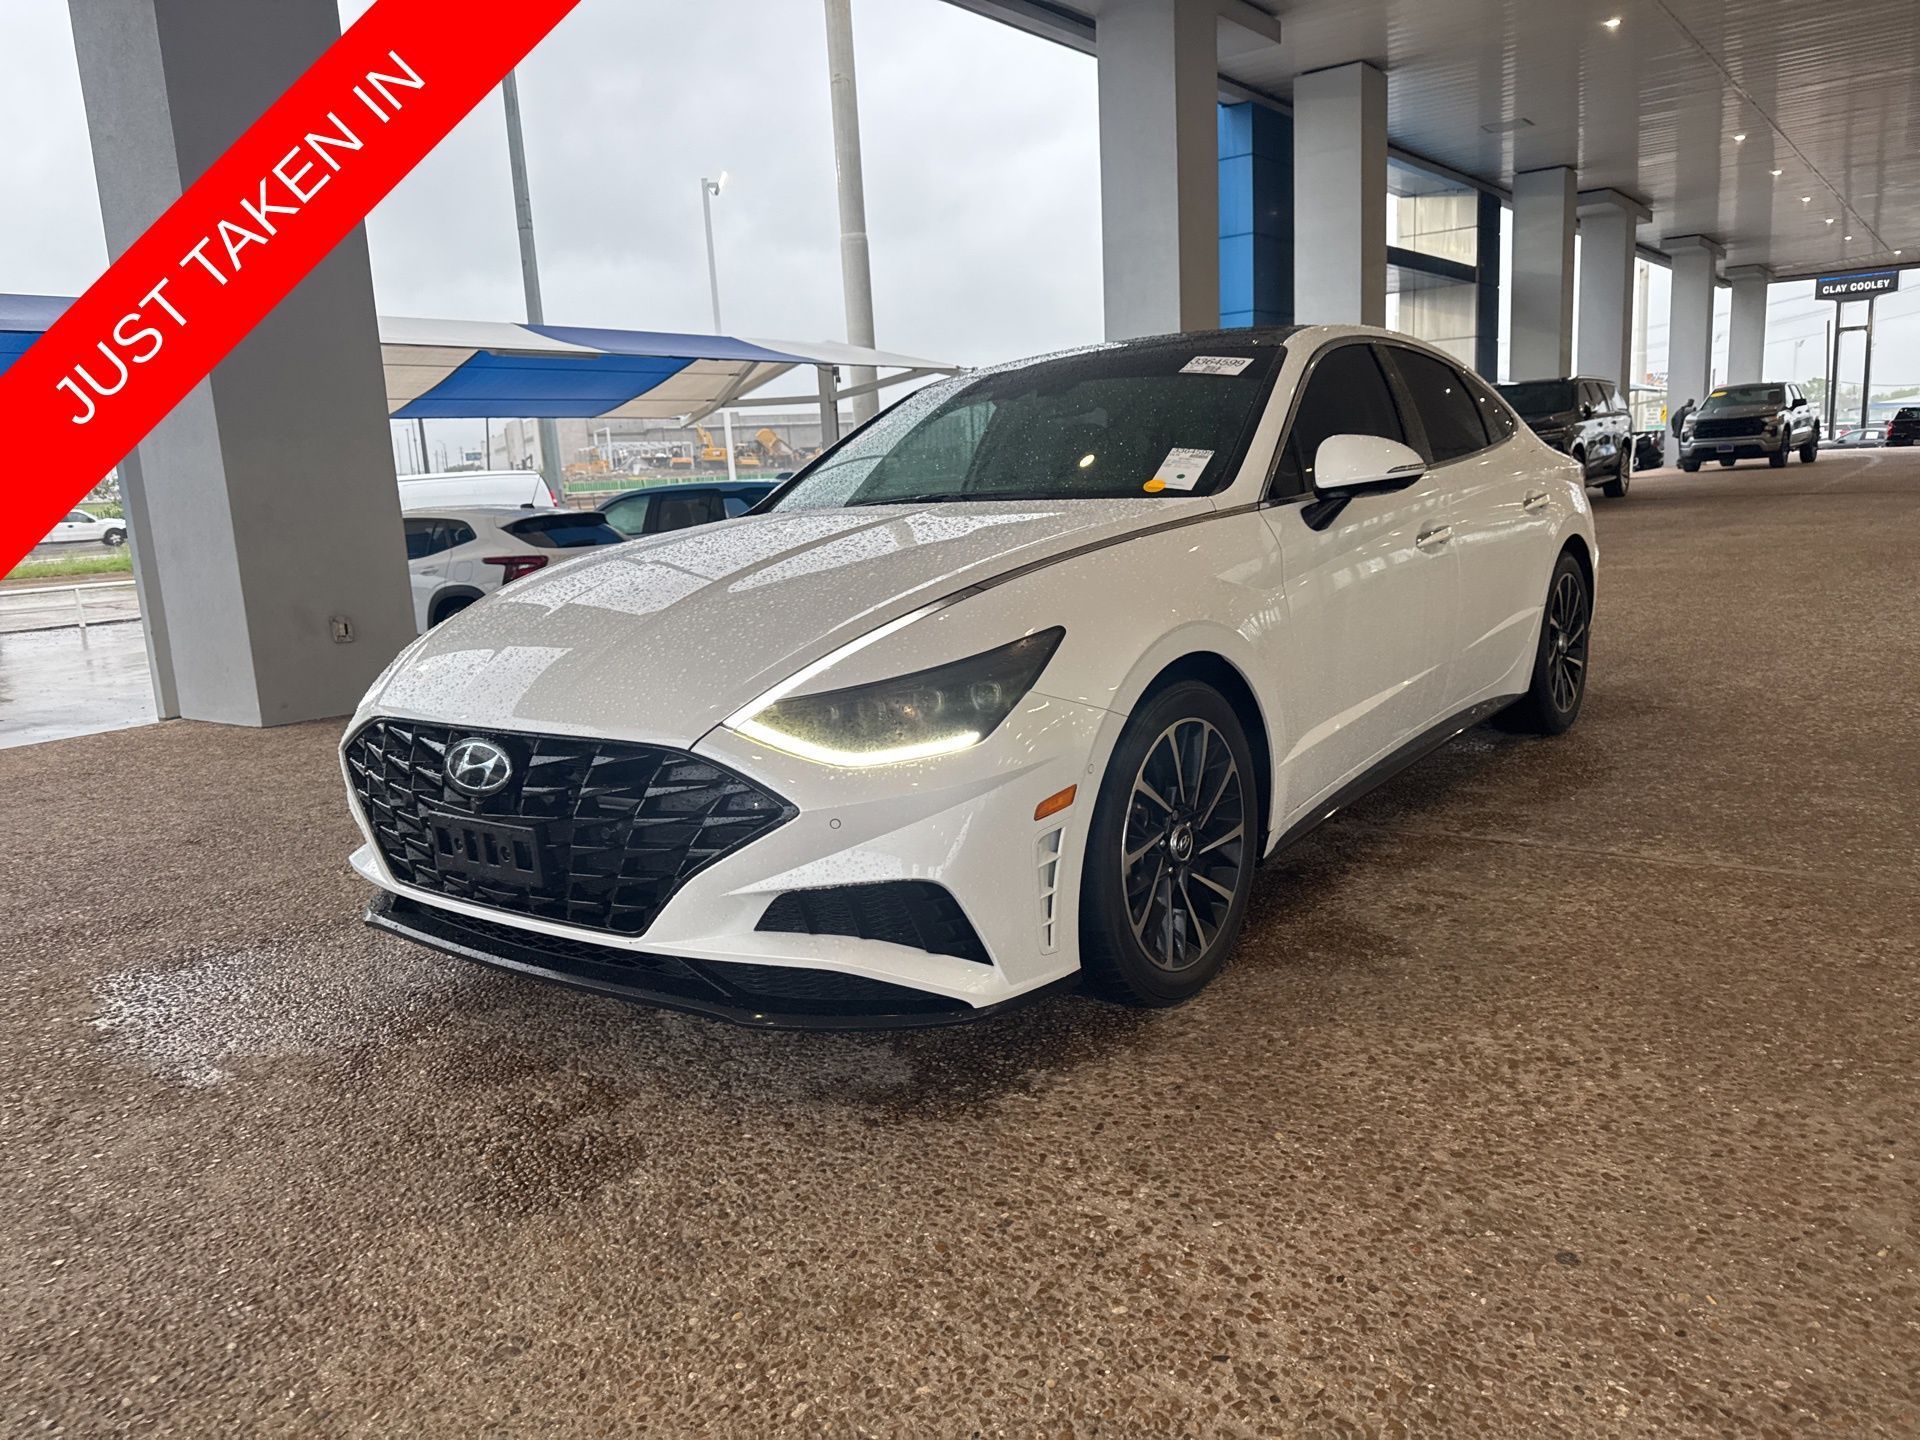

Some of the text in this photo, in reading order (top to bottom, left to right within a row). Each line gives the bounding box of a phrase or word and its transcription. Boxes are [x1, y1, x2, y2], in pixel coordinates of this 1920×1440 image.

[1822, 279, 1890, 294] CLAY COOLEY
[1190, 357, 1246, 366] 3364599
